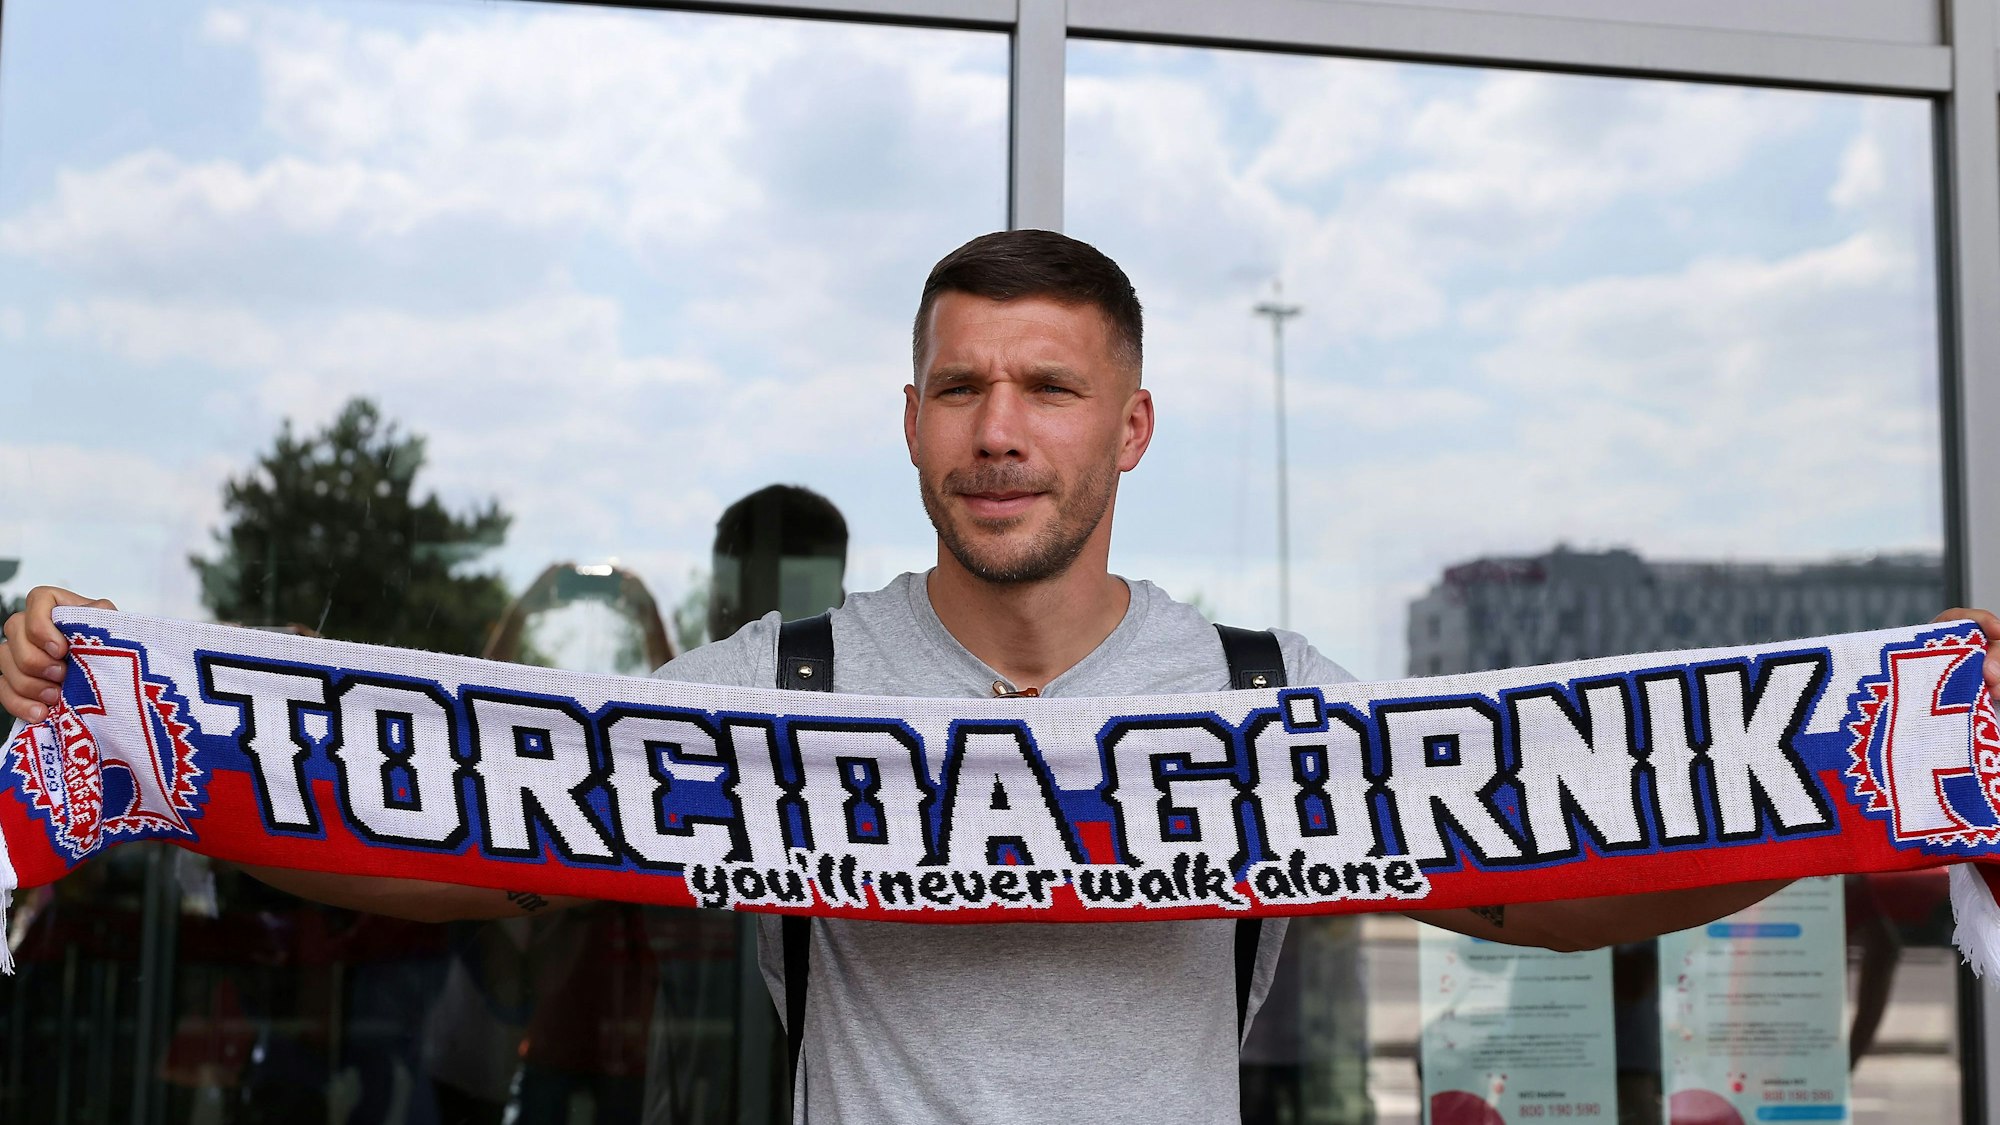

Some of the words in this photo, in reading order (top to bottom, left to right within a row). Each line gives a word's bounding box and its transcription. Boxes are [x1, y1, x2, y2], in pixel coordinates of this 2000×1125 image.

[201, 656, 1083, 868] TORCIDA
[1104, 646, 1835, 866] GÓRNIK
[692, 852, 862, 908] you'll
[879, 869, 1058, 905] never
[1078, 852, 1245, 905] walk
[1254, 850, 1423, 899] alone
